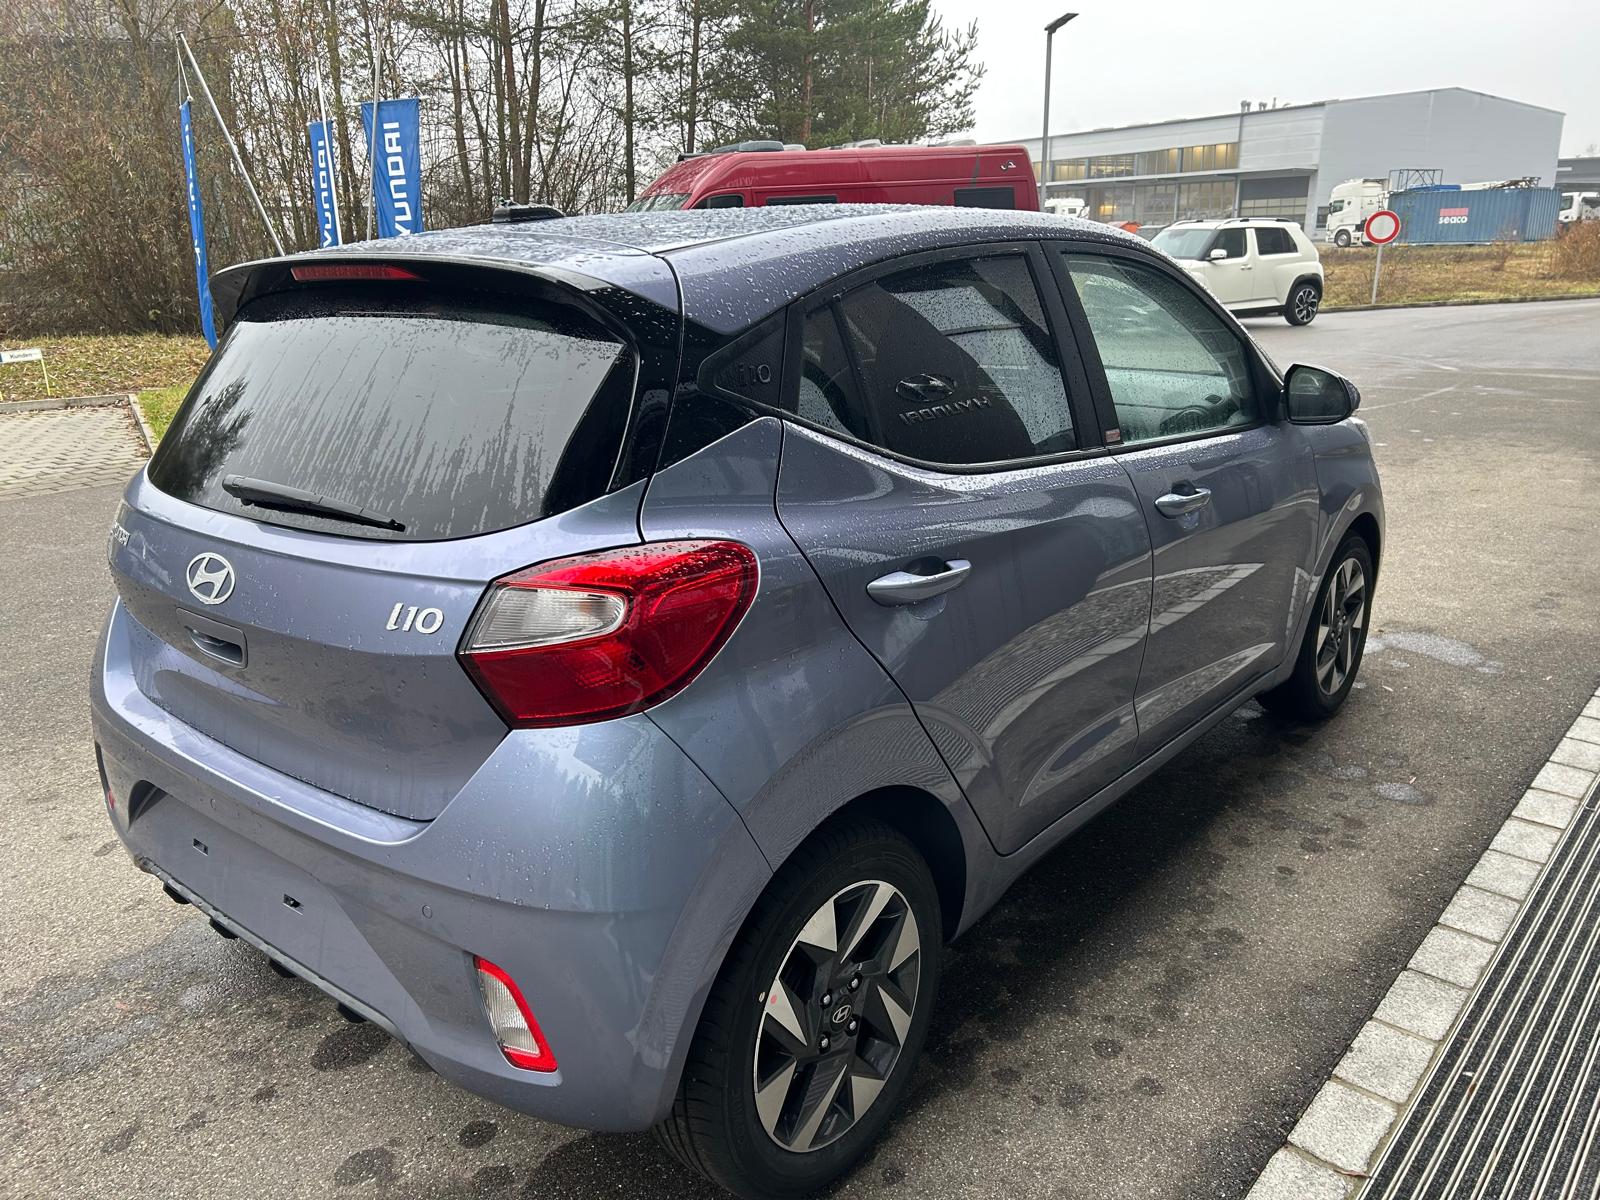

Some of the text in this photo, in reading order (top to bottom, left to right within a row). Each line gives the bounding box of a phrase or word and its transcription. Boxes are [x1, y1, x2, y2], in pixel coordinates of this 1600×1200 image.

[317, 140, 332, 249] YUNDAI
[383, 122, 412, 237] YUNDAI
[1438, 216, 1468, 225] seaco
[386, 602, 444, 635] i10
